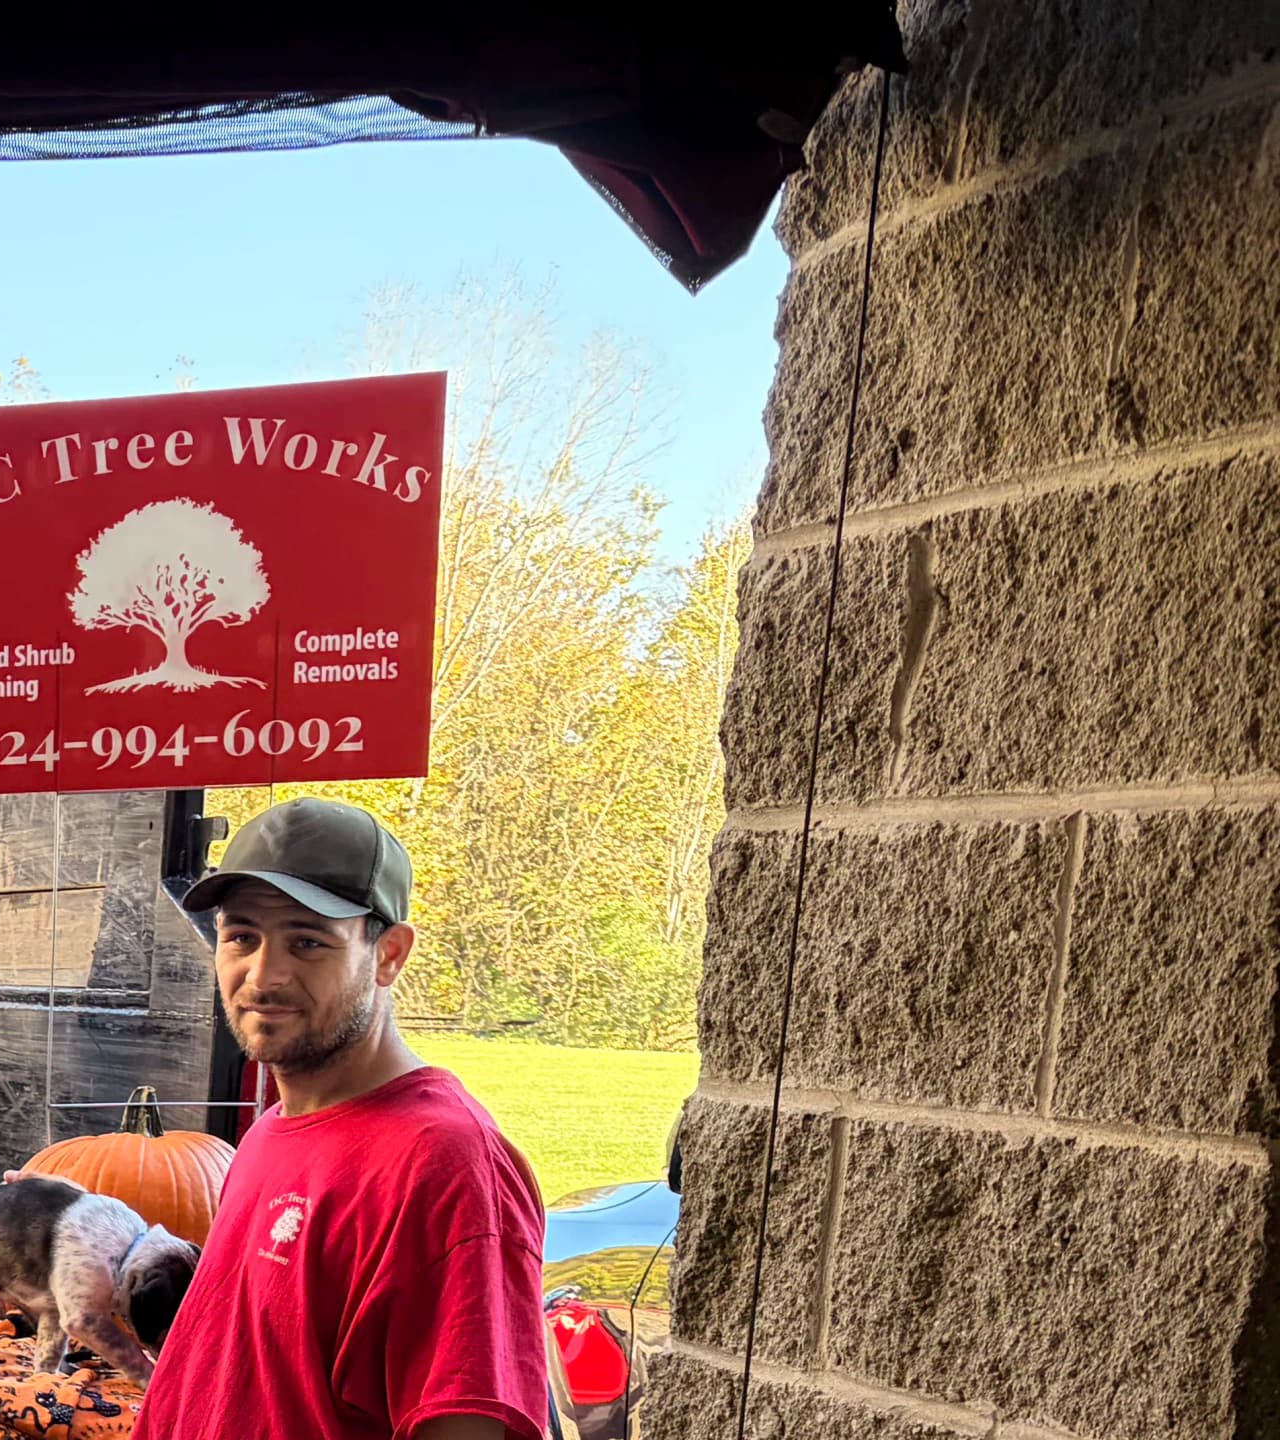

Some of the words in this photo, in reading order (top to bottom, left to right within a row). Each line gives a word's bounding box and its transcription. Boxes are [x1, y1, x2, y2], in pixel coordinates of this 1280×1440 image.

[41, 427, 194, 485] Tree
[222, 416, 433, 503] Works
[14, 642, 75, 667] Shrub
[294, 626, 400, 656] Complete
[293, 656, 399, 684] Removals
